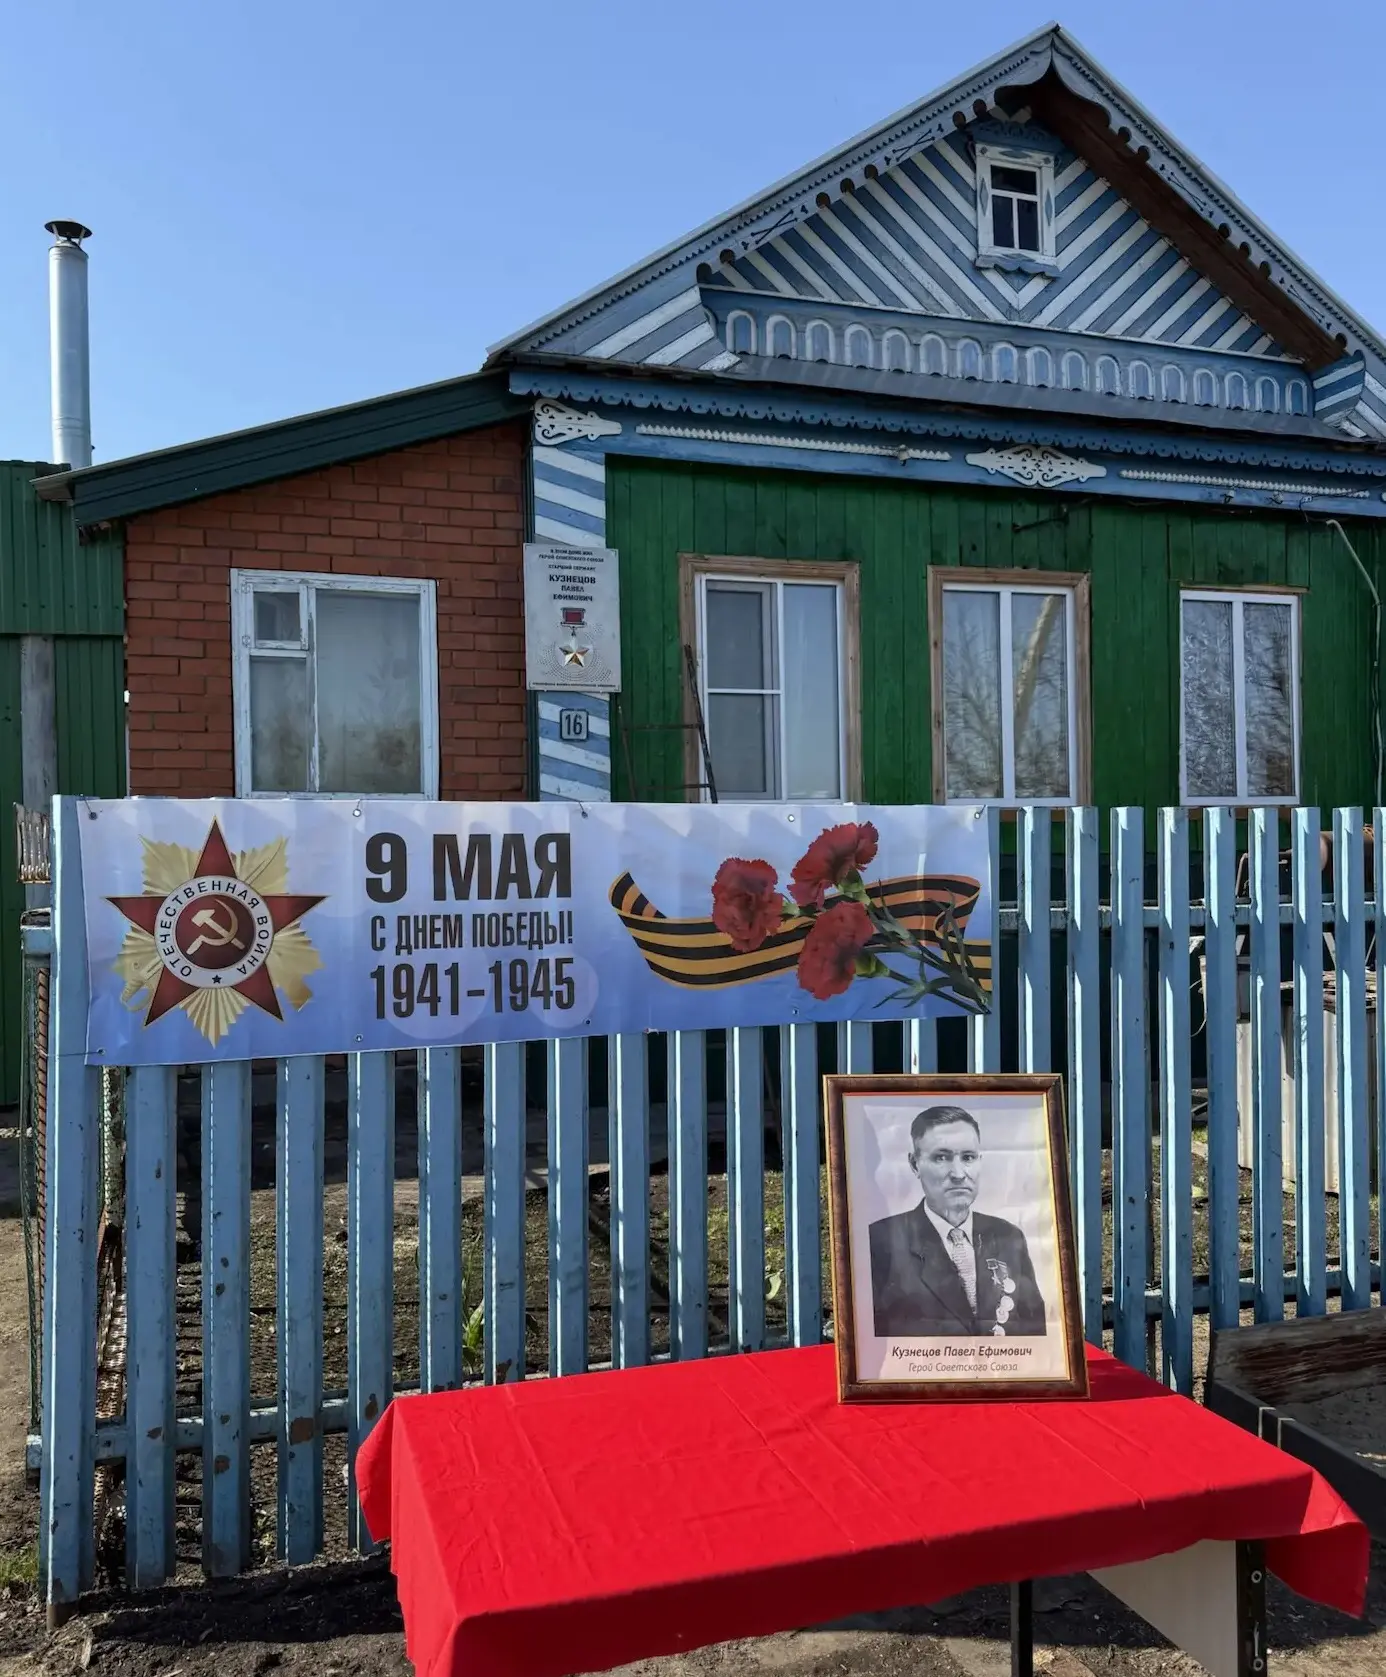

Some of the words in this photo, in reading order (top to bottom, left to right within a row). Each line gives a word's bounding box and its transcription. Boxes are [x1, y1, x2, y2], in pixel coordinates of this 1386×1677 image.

[549, 575, 596, 584] КУЗНЕЦОВ
[566, 714, 582, 735] 16
[366, 832, 407, 903] 9
[433, 833, 571, 901] МАЯ
[160, 880, 259, 977] ОТЕЧЕСТВЕННАЯ
[371, 915, 386, 951] С
[396, 914, 463, 956] ДНЕМ
[472, 910, 573, 950] ПОБЕДЫ!
[892, 1346, 940, 1359] Кузнецов
[944, 1346, 975, 1357] Павел
[978, 1346, 1032, 1359] Ефимович
[908, 1363, 932, 1372] Герой
[935, 1362, 987, 1373] Советского
[990, 1362, 1018, 1371] Союза
